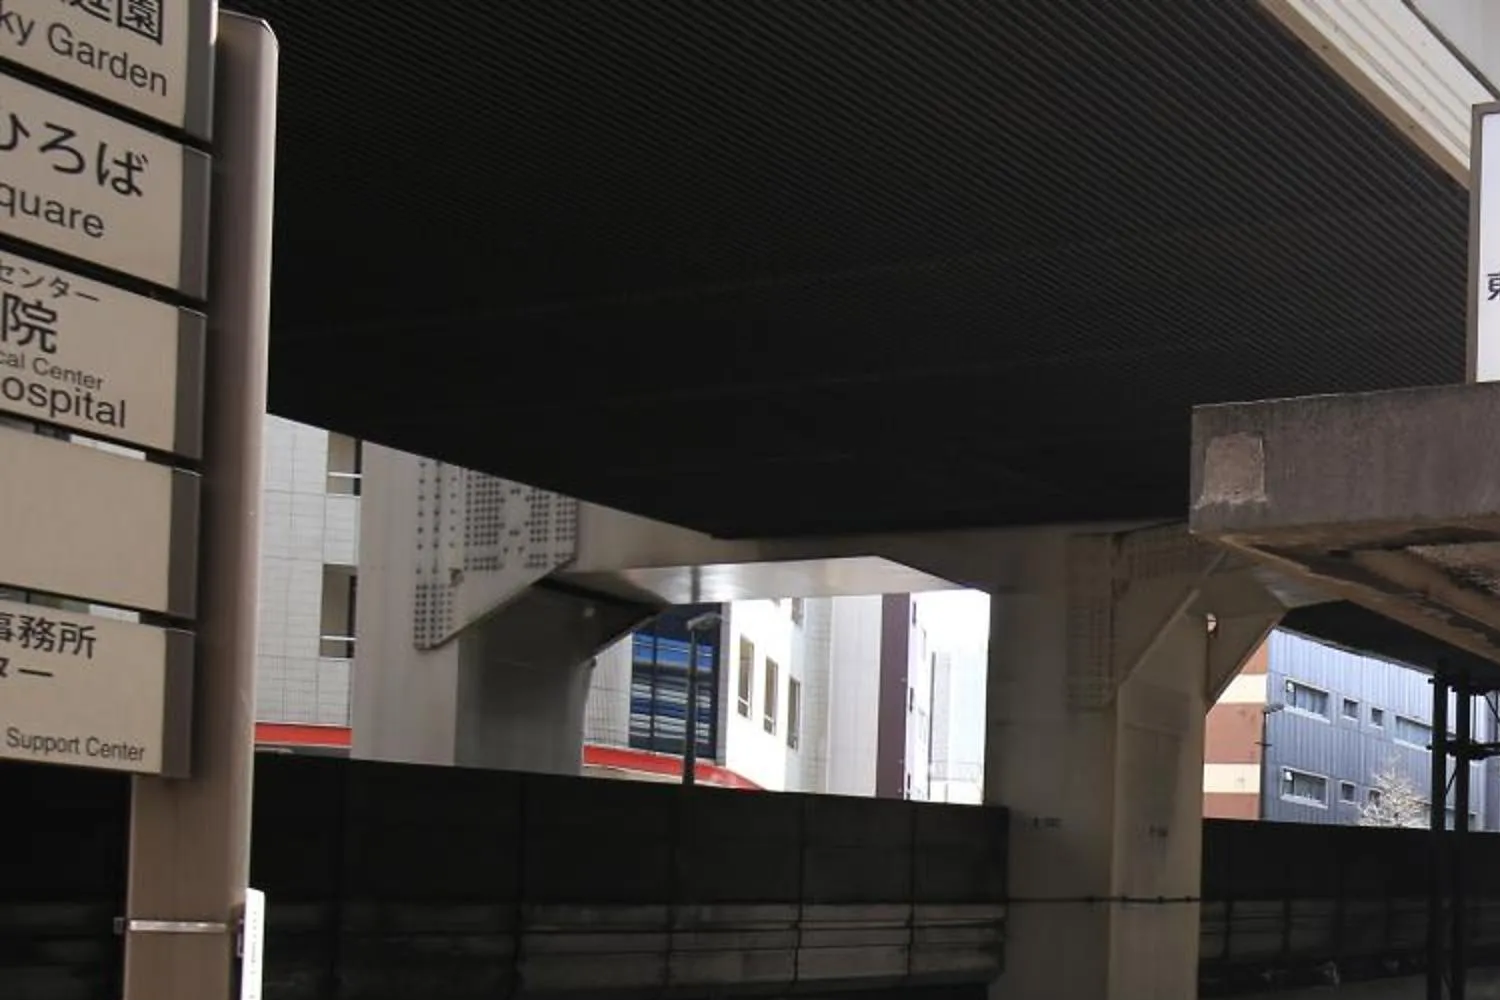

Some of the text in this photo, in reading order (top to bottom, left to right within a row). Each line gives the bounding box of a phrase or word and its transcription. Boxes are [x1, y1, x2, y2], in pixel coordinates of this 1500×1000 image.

[47, 22, 167, 97] Garden
[32, 357, 103, 391] Center
[6, 726, 146, 762] Support Center
